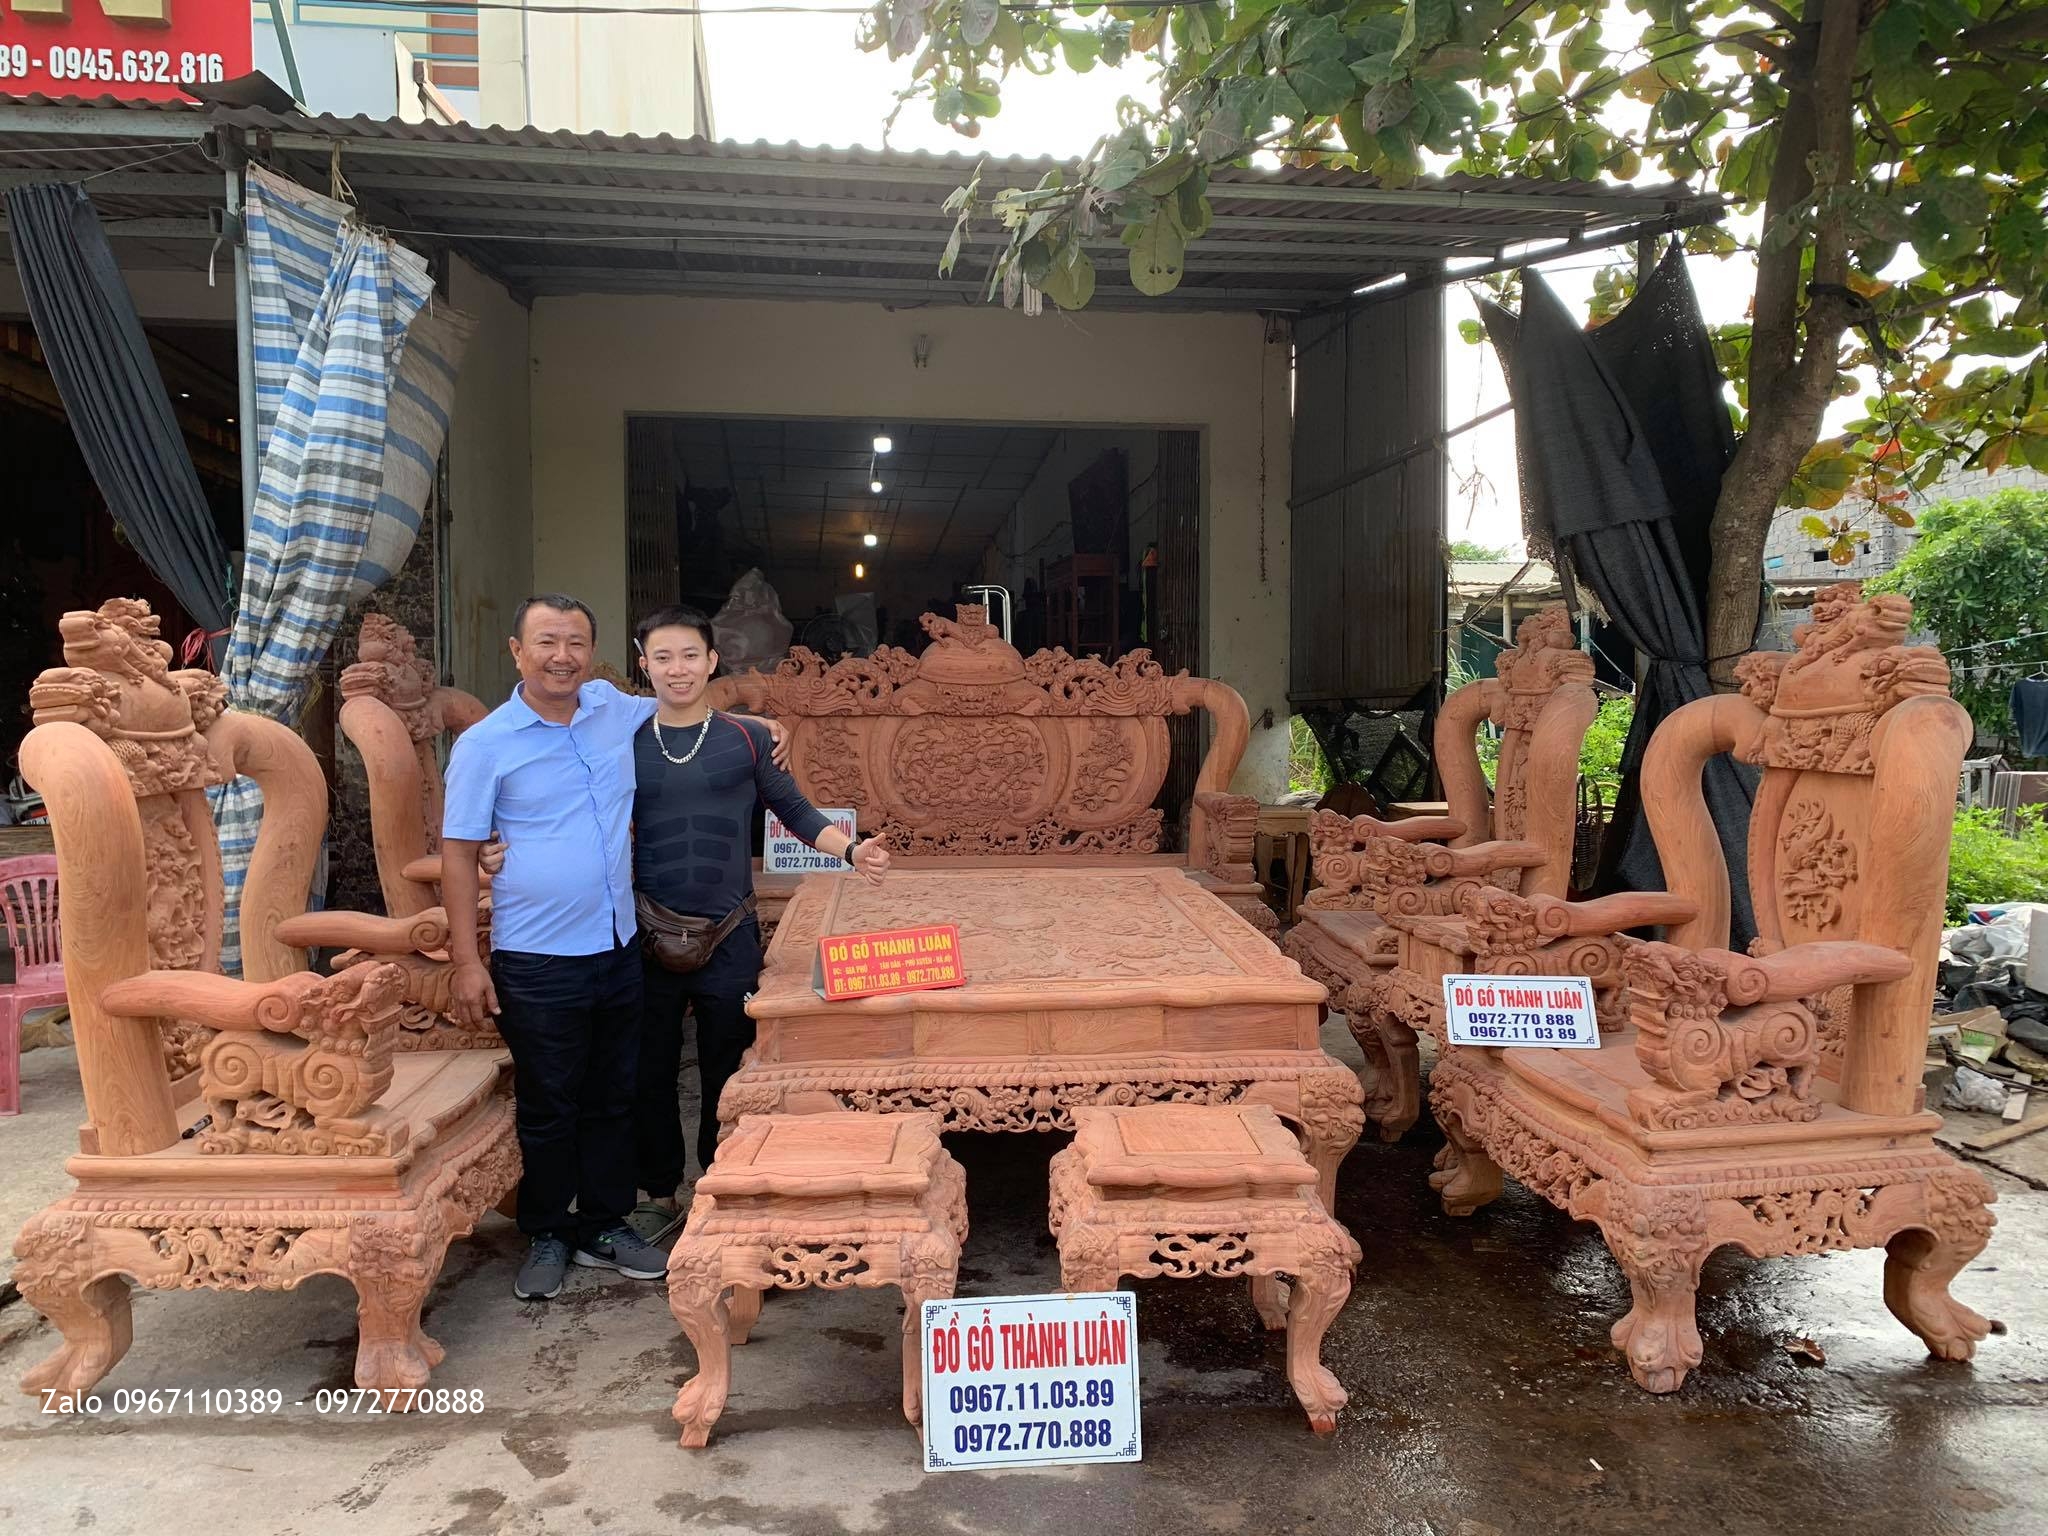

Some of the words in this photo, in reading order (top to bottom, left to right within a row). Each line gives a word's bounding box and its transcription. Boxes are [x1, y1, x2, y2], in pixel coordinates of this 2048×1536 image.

[0, 44, 27, 78] 89
[49, 45, 223, 83] 0945.632.816
[775, 856, 842, 868] 0972.770.888
[829, 940, 849, 963] ĐỒ
[851, 937, 870, 960] GỖ
[872, 937, 916, 958] THÀNH
[918, 932, 952, 952] LUÂN
[847, 972, 900, 991] 0967.11.03.89
[906, 966, 955, 984] 0972.770.888
[1455, 982, 1473, 1006] ĐỒ
[1477, 982, 1495, 1007] GỖ
[1498, 986, 1543, 1008] THÀNH
[1547, 988, 1583, 1009] LUÂN
[1468, 1012, 1541, 1025] 0972.770
[1545, 1014, 1575, 1026] 888
[1470, 1026, 1529, 1038] 0967.11
[1535, 1027, 1554, 1039] 03
[1558, 1028, 1577, 1040] 89
[933, 1312, 960, 1373] ĐỒ
[967, 1308, 994, 1372] GỖ
[1000, 1313, 1067, 1369] THÀNH
[1073, 1311, 1127, 1366] LUÂN
[950, 1379, 1114, 1414] 0967.11.03.89
[954, 1419, 1112, 1453] 0972.770.888
